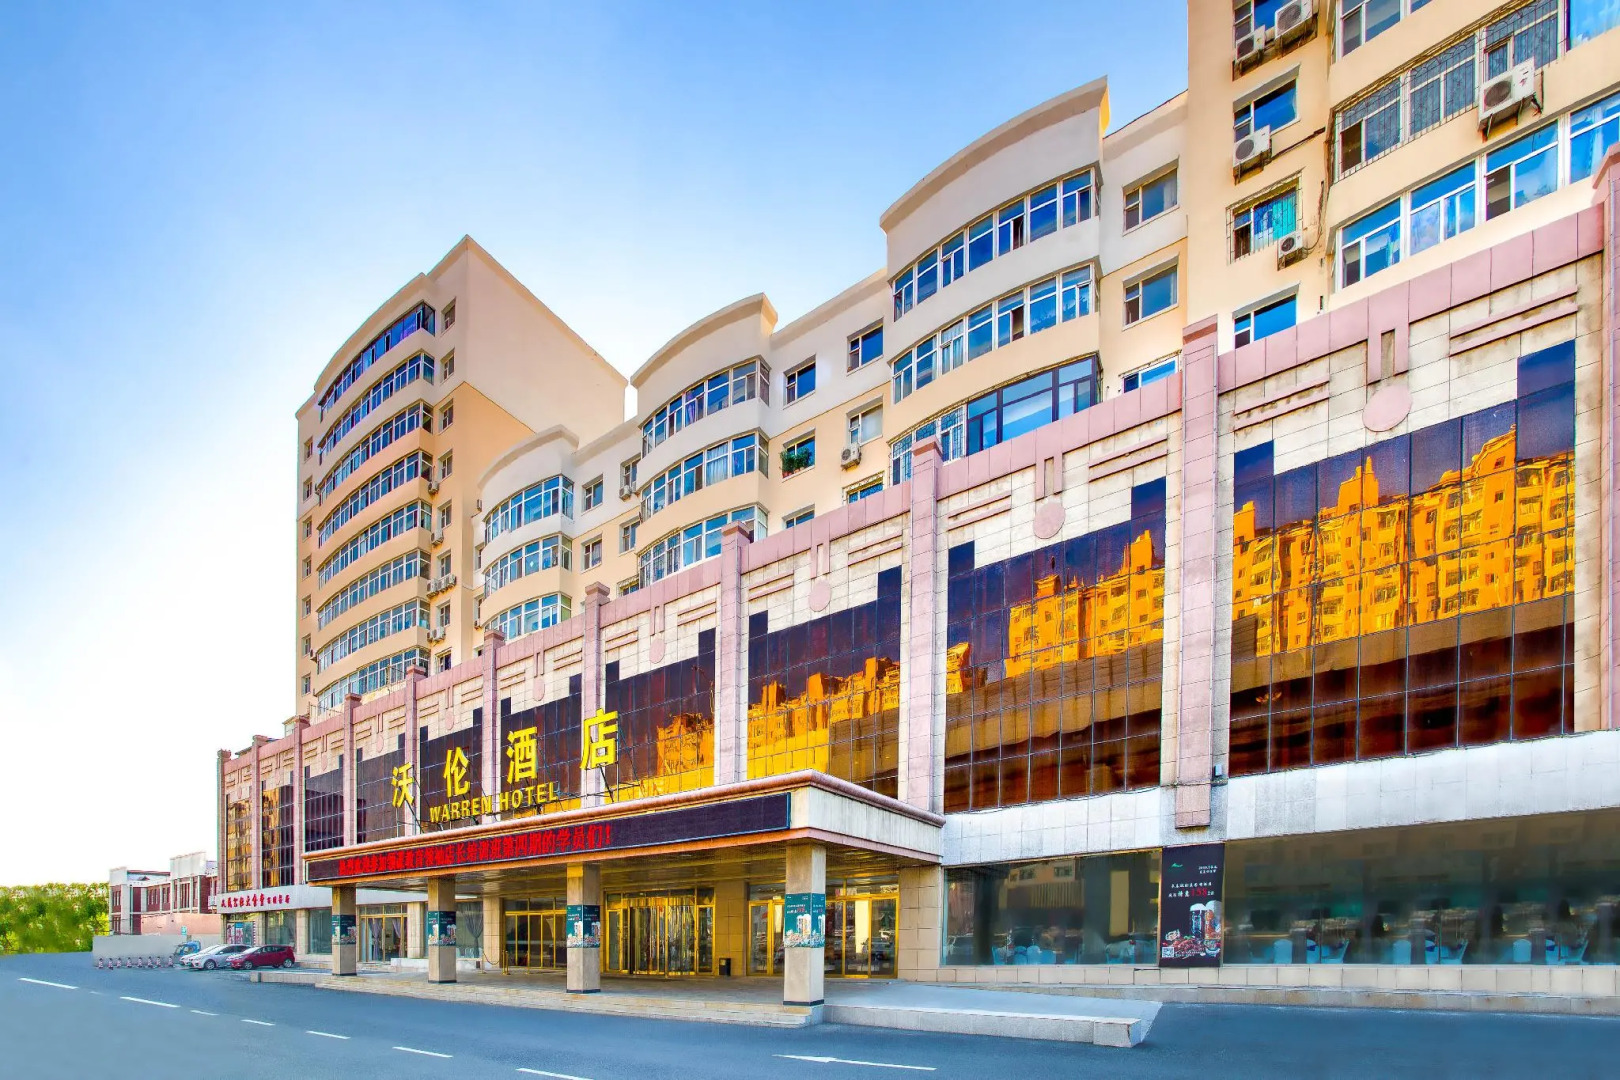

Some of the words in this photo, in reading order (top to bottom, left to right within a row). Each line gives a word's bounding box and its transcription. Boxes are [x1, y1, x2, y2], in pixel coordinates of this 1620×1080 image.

[391, 708, 618, 808] 沃伦酒店
[429, 795, 493, 823] WARREN
[498, 781, 558, 811] HOTEL
